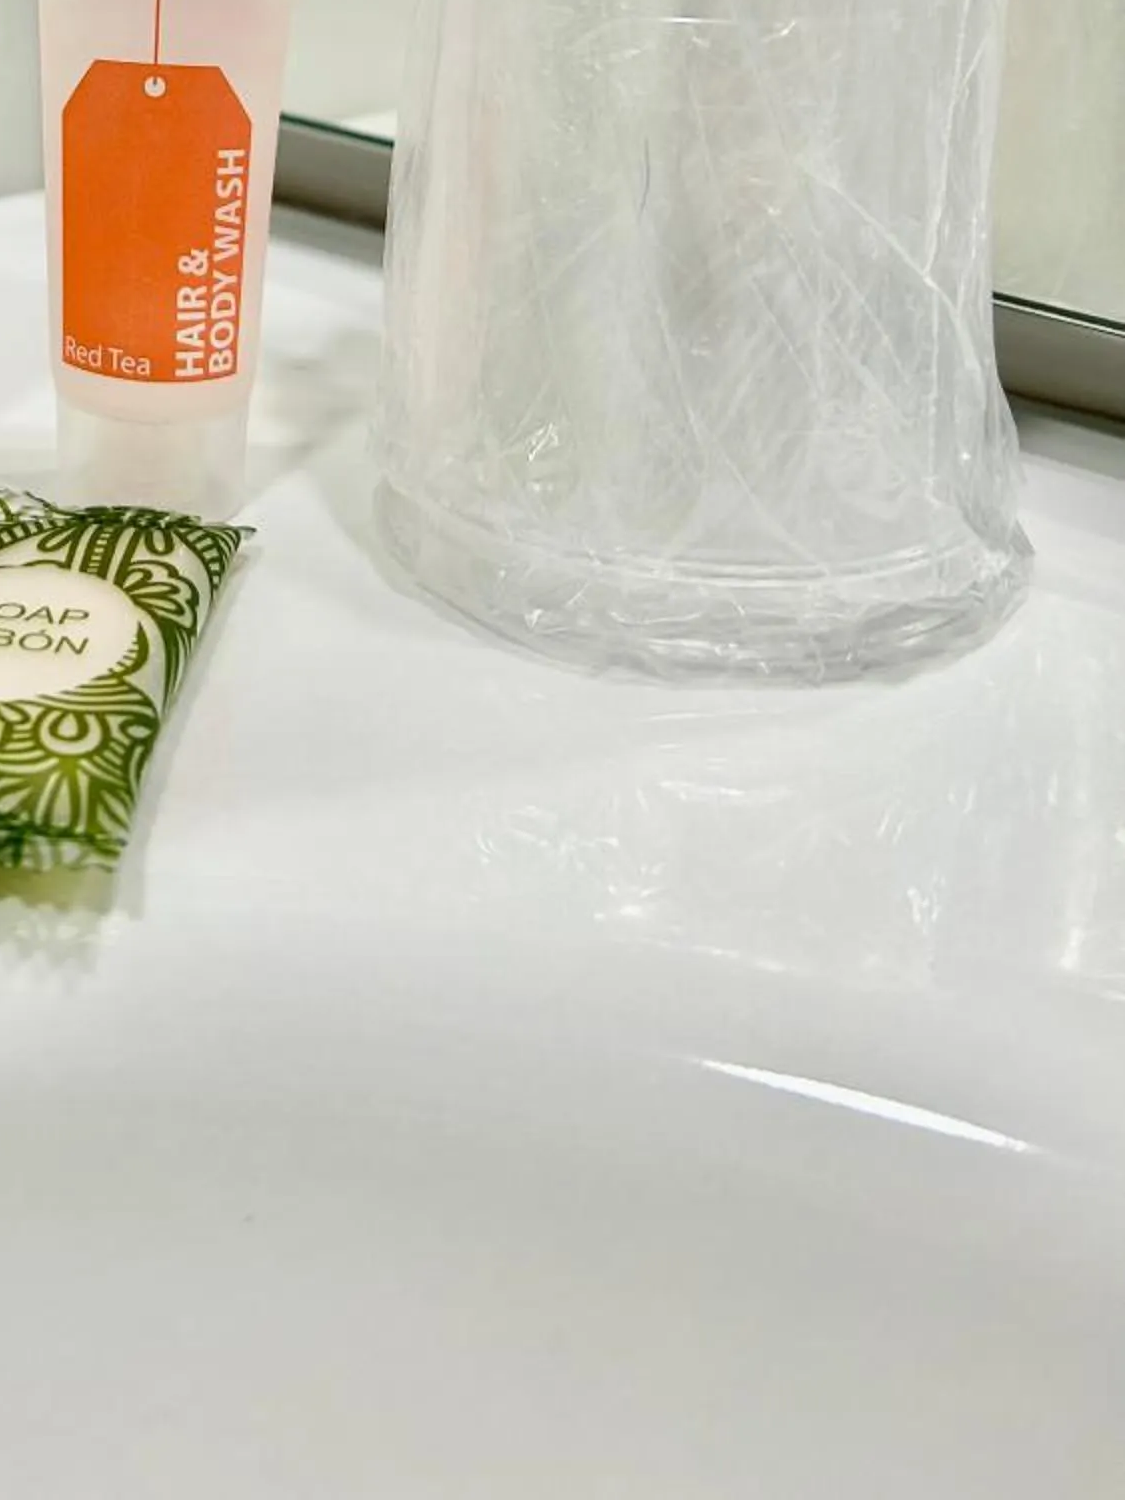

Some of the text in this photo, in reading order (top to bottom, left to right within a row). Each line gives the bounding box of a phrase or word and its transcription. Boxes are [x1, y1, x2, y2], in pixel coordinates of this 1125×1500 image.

[175, 247, 209, 379] HAIR &
[208, 148, 245, 376] BODY WASH
[64, 336, 151, 377] Red Tea
